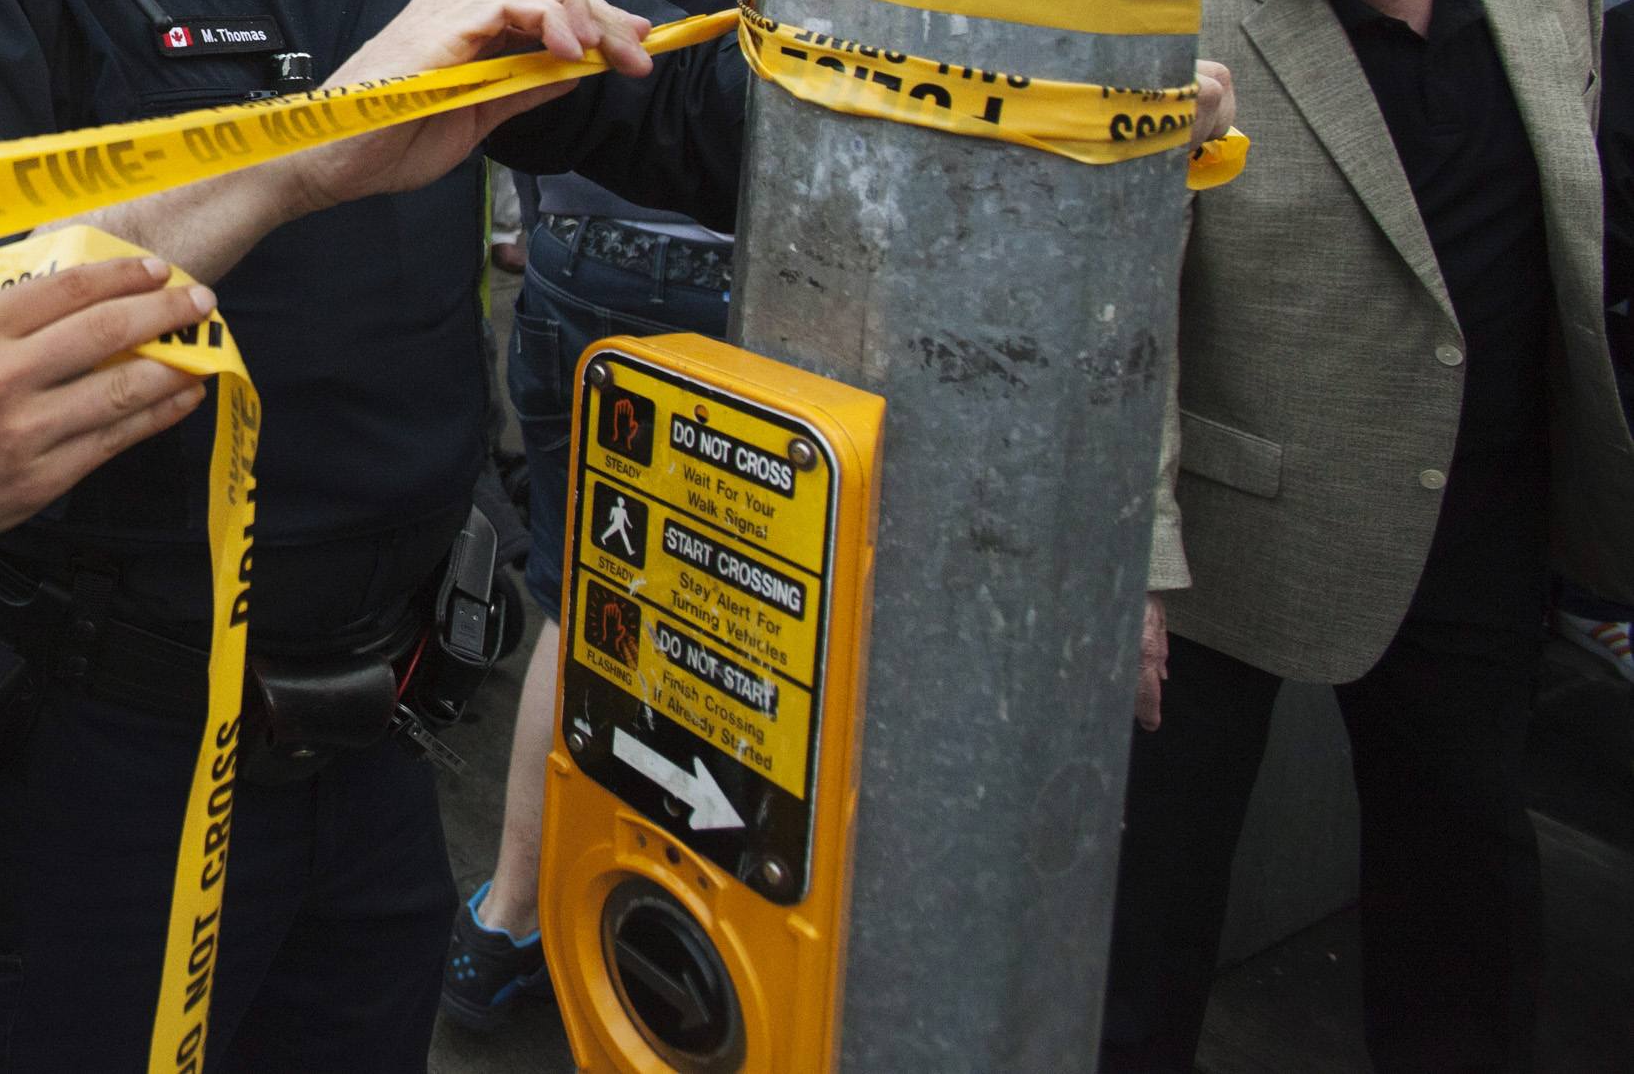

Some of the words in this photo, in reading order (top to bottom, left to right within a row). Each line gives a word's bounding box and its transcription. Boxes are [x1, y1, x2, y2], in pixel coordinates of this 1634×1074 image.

[200, 29, 217, 43] M.
[216, 28, 267, 43] Thomas
[605, 455, 643, 480] STEADY
[672, 420, 696, 449] DO
[699, 430, 732, 464] NOT
[735, 446, 792, 491] CROSS
[683, 464, 711, 490] Wait
[717, 480, 739, 502] For
[745, 491, 776, 518] Your
[687, 490, 718, 518] Walk
[725, 509, 767, 540] Signal
[598, 556, 634, 581] STEADY
[665, 526, 714, 566] START
[717, 552, 802, 613] CROSSING
[670, 589, 720, 631] Turning
[726, 620, 788, 665] Vehicles
[679, 572, 711, 601] Stay
[717, 590, 751, 621] Alert
[757, 612, 782, 636] For
[586, 649, 633, 686] FLASHING
[653, 686, 662, 703] If
[659, 629, 682, 659] DO
[686, 645, 718, 678] NOT
[723, 664, 776, 710] START
[662, 670, 700, 702] Finish
[704, 694, 765, 744] Crossing
[200, 714, 242, 892] CROSS
[183, 901, 219, 1015] NOT
